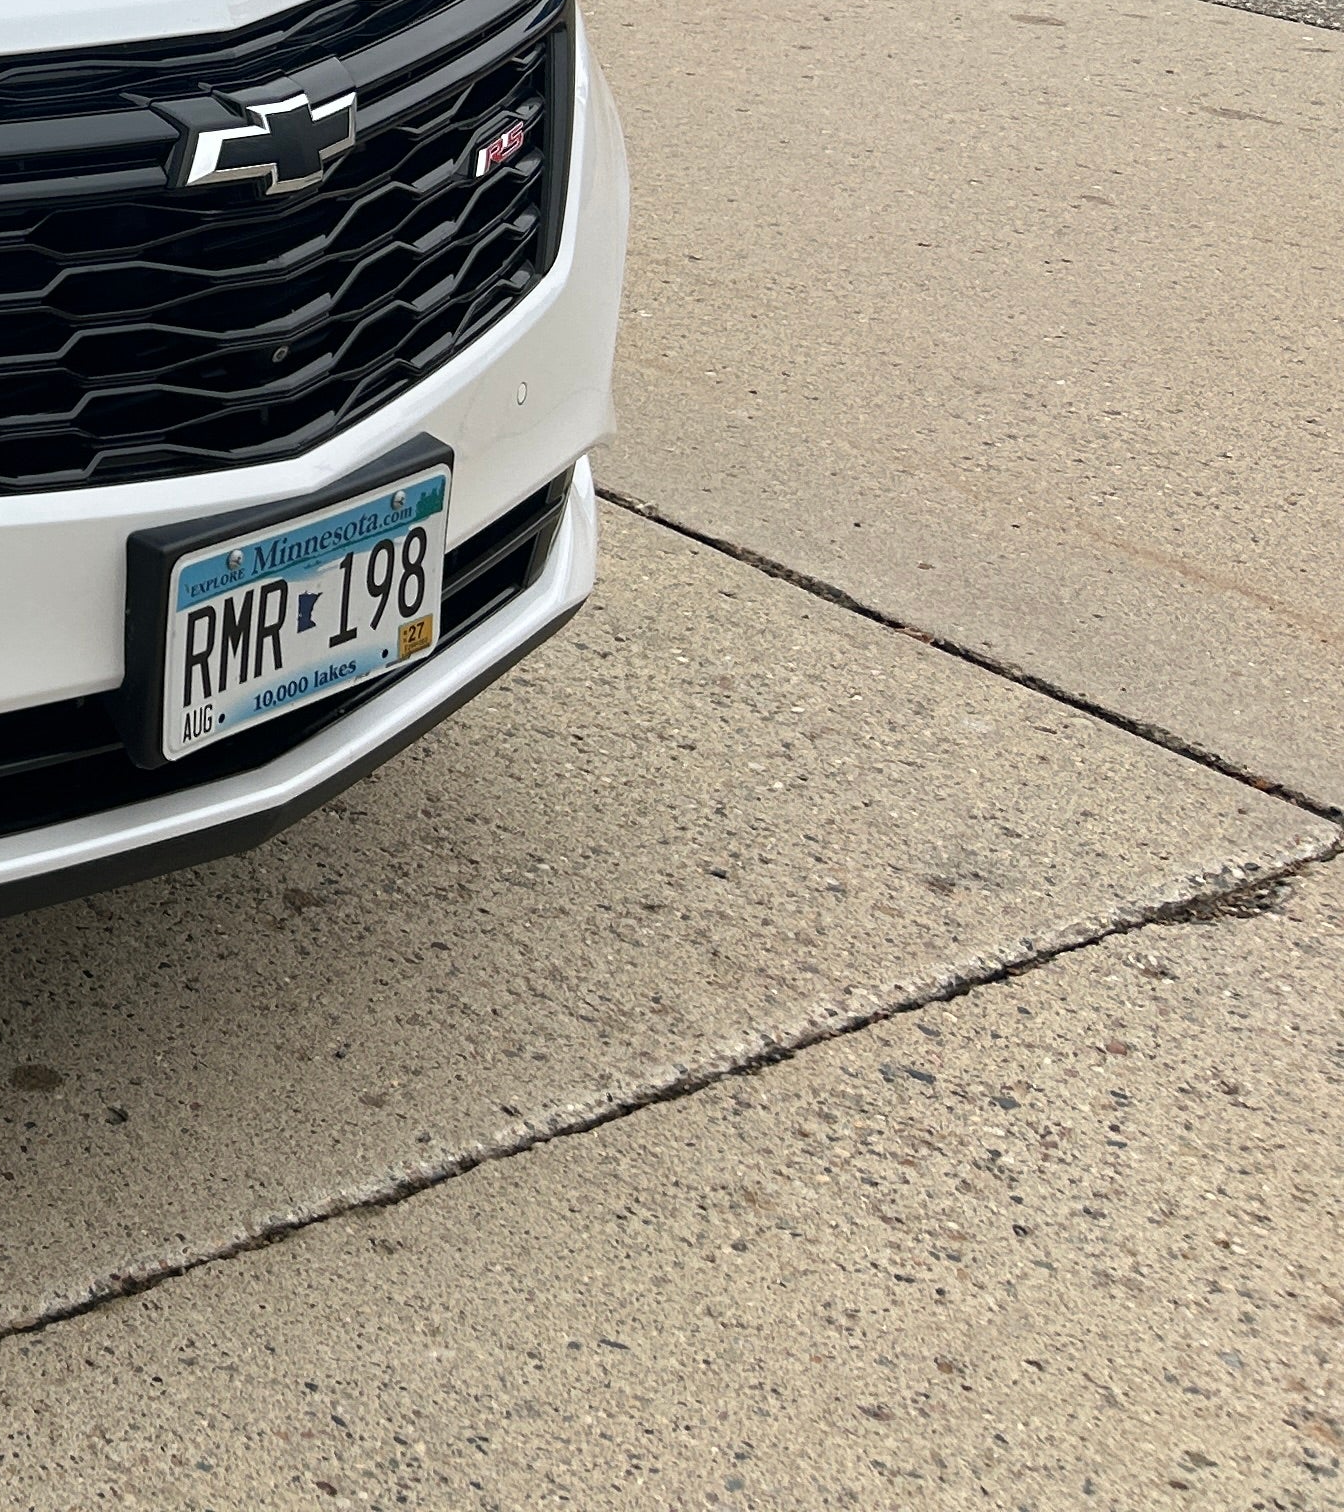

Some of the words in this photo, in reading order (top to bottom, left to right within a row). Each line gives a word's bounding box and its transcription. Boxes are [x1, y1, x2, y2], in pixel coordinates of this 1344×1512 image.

[475, 121, 524, 178] RS
[190, 567, 246, 598] EXPLORE
[251, 505, 413, 575] Minnesota.com
[183, 578, 289, 708] RMR
[328, 526, 428, 649] 198
[407, 621, 425, 644] 27
[252, 676, 309, 712] 10,000
[314, 659, 357, 688] lakes
[183, 703, 213, 743] AUG
